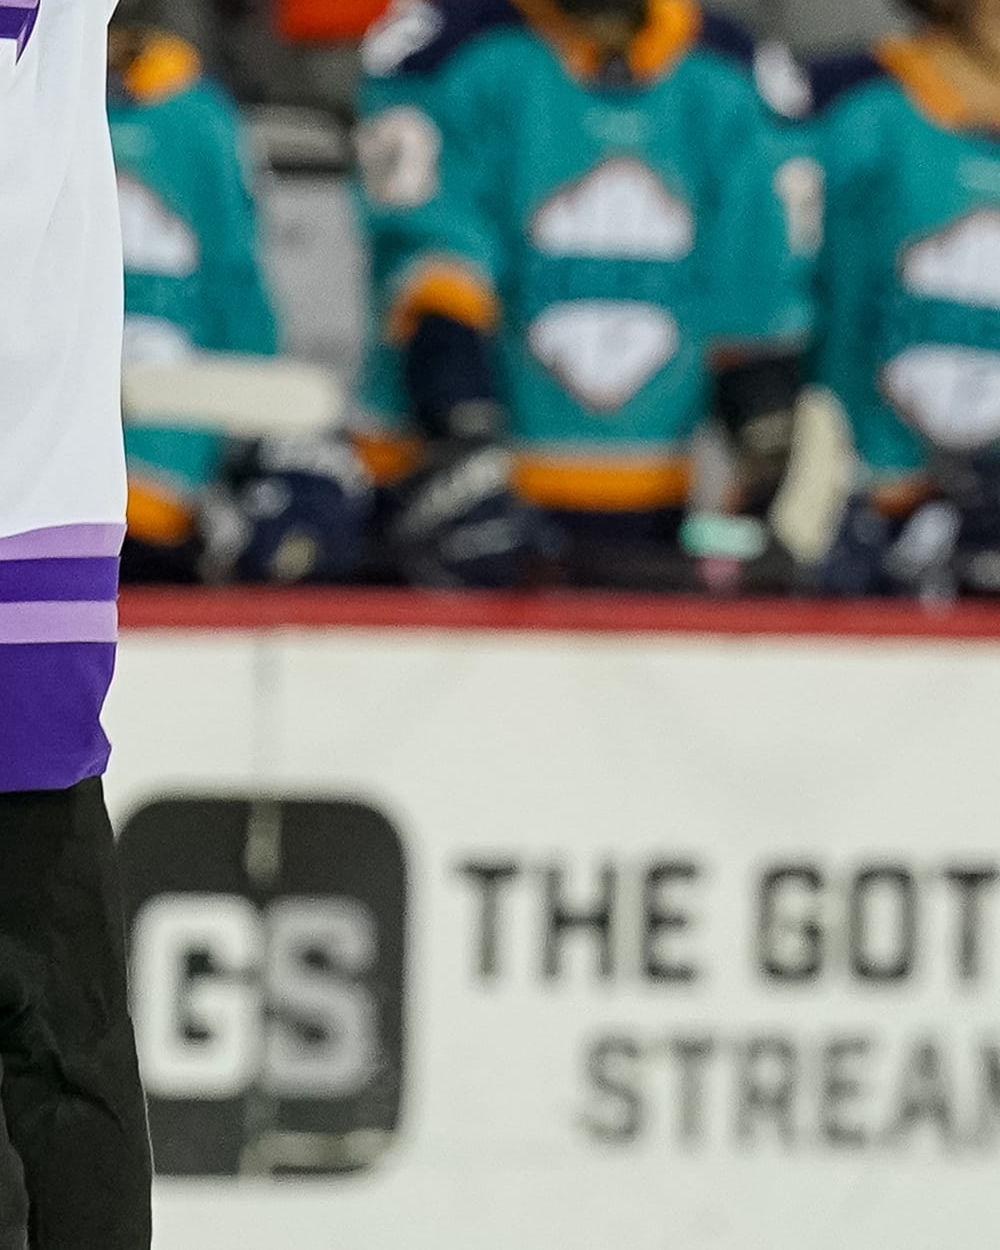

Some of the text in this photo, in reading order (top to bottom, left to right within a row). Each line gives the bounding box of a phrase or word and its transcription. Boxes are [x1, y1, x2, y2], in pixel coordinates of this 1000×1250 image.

[132, 891, 379, 1100] GS
[460, 860, 1000, 984] THE GOT
